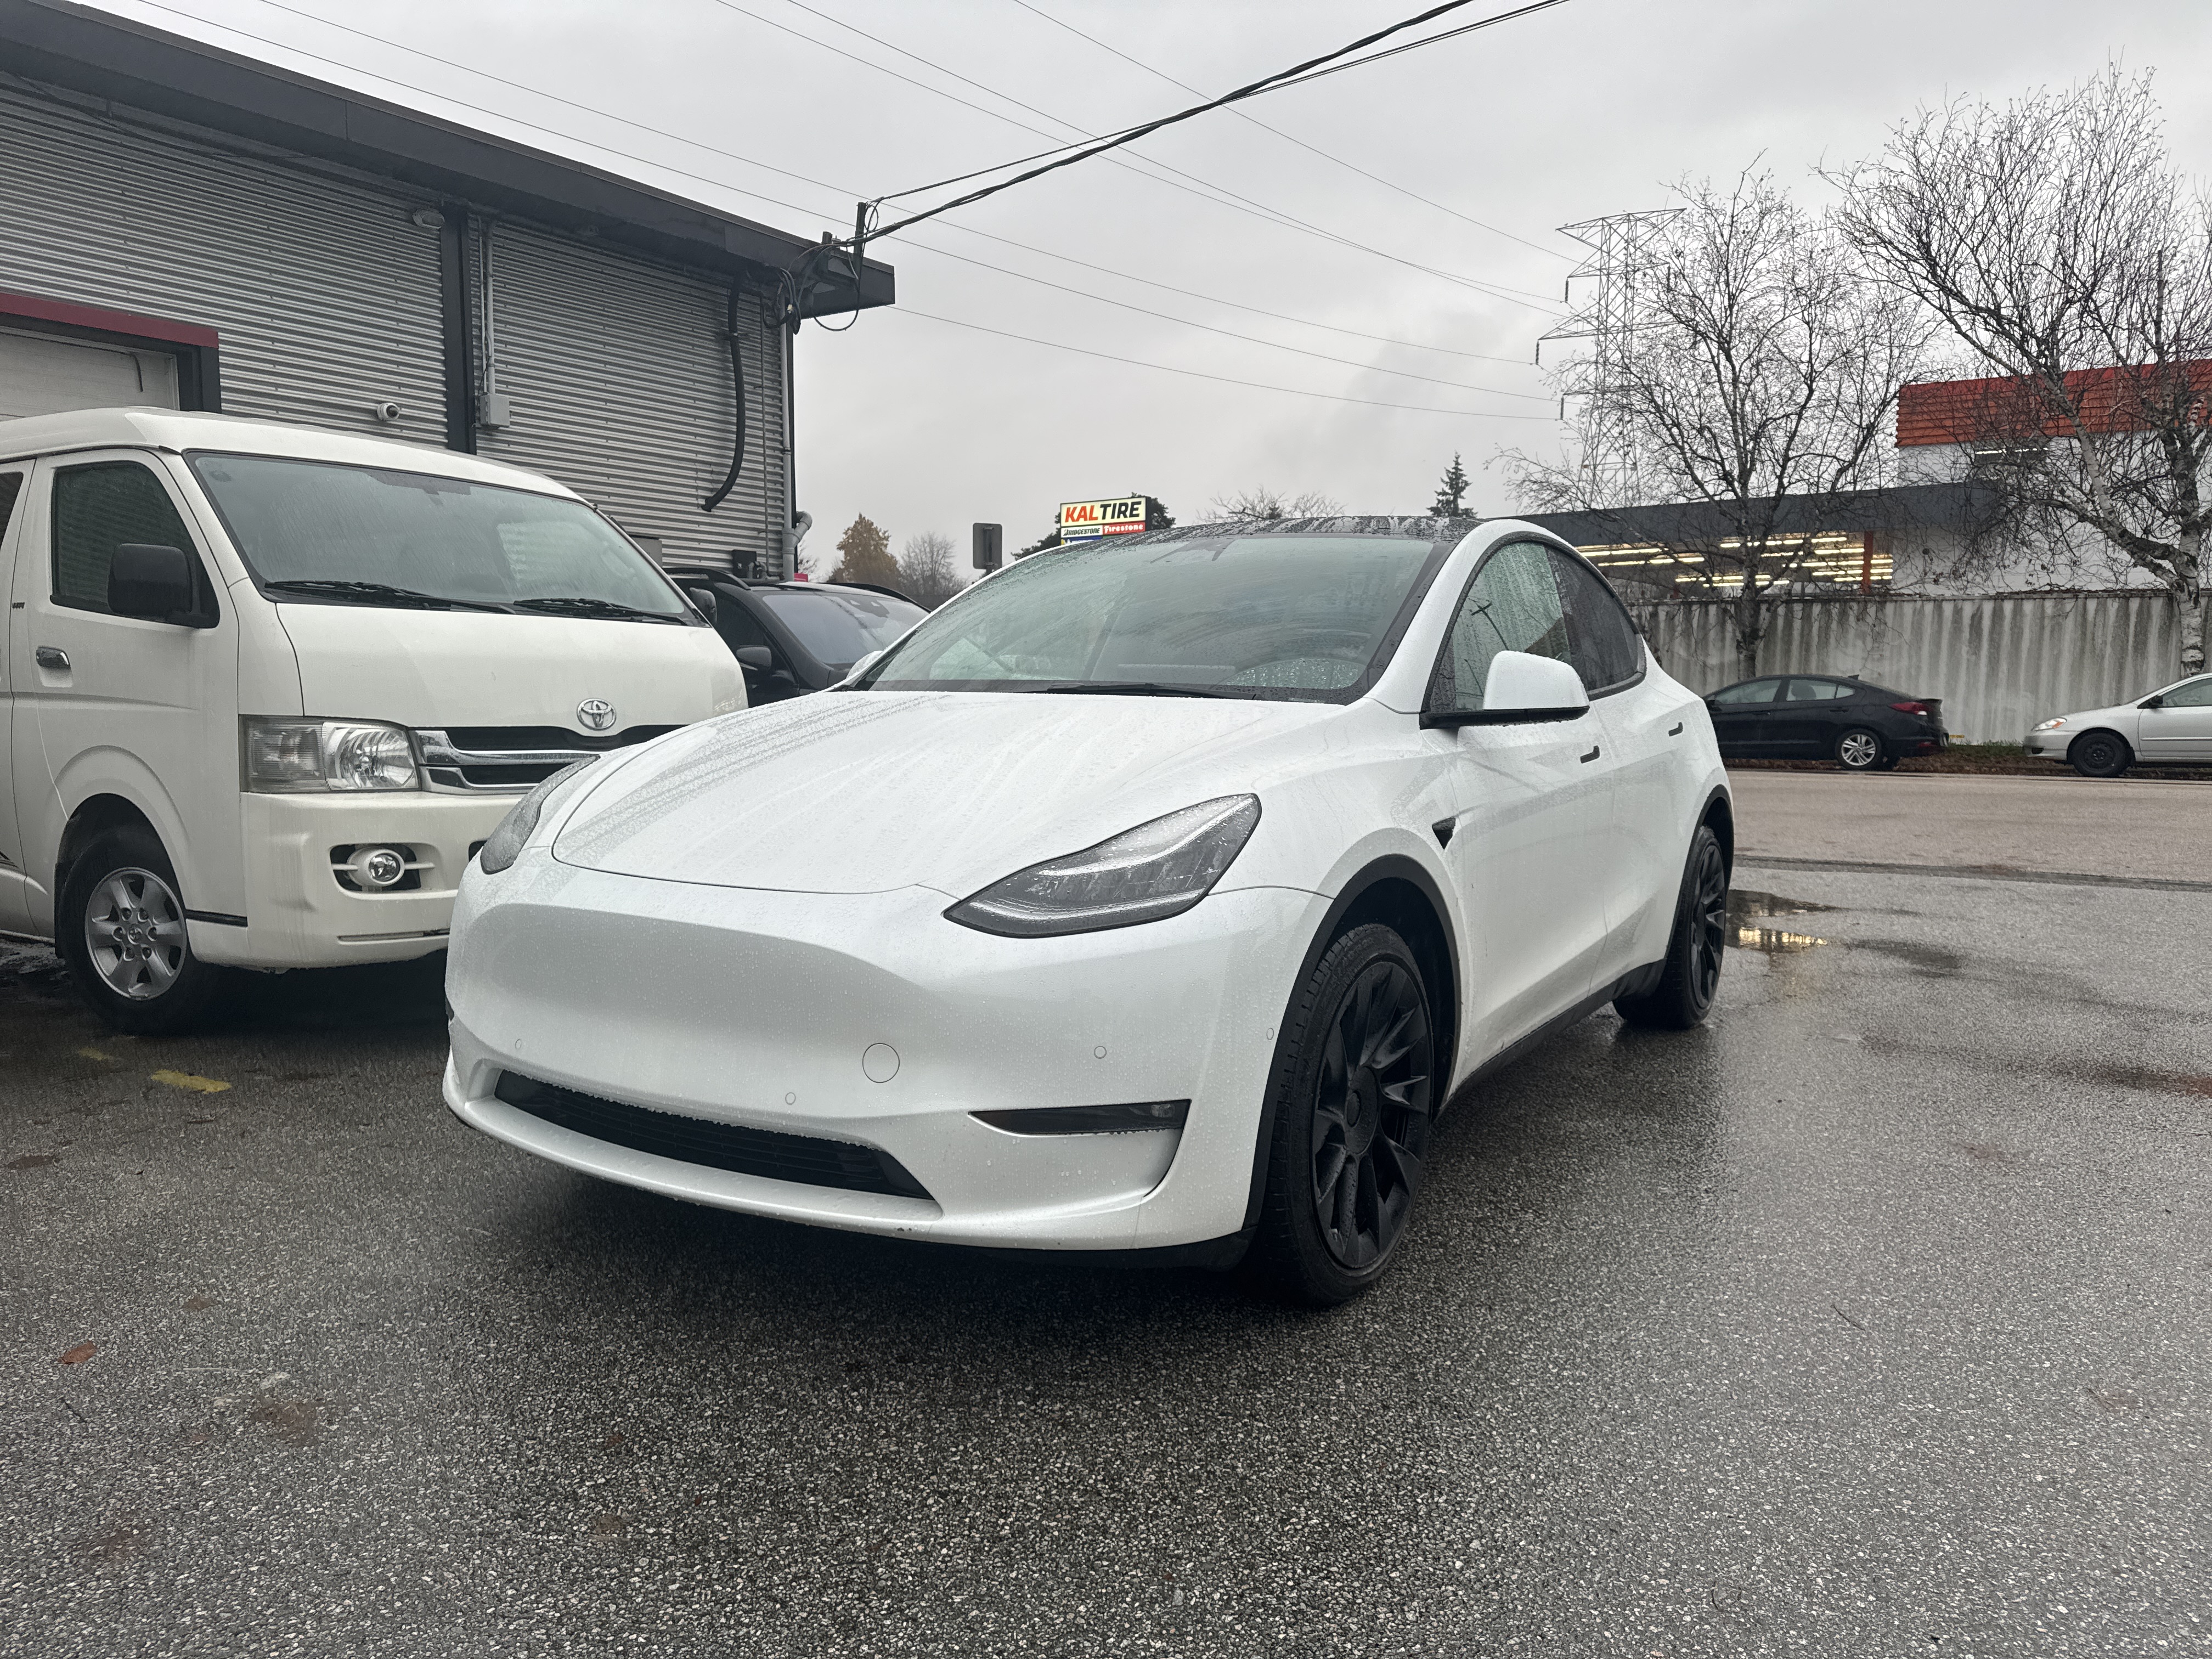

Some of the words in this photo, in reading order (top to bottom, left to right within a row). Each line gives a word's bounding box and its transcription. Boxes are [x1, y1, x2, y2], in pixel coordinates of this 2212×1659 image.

[1065, 505, 1098, 523] KAL
[1100, 501, 1142, 520] TIRE
[1063, 528, 1101, 536] BRIDGESTONE
[1104, 524, 1144, 534] Firestone
